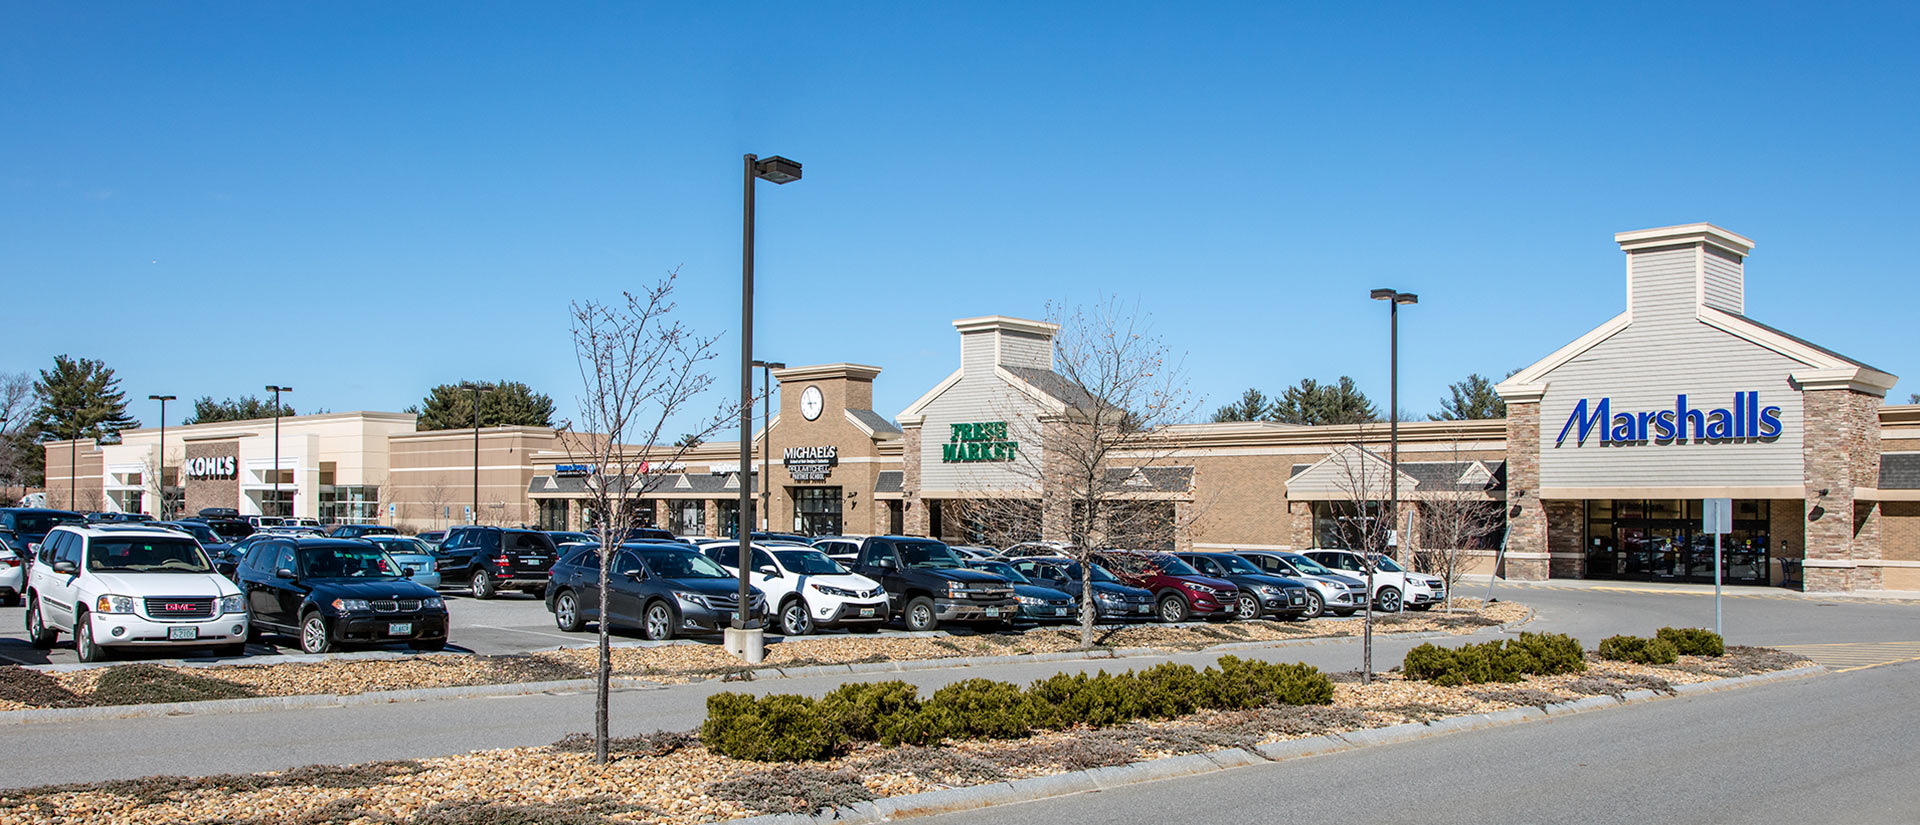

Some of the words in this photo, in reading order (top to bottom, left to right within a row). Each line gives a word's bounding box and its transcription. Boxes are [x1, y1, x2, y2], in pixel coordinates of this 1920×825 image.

[1556, 390, 1783, 442] Marshalls
[949, 421, 1009, 441] FRESH
[783, 444, 836, 459] MICHAEL'S
[941, 441, 1019, 460] MARKET
[185, 455, 236, 476] KOHL'S
[165, 603, 196, 611] GMC
